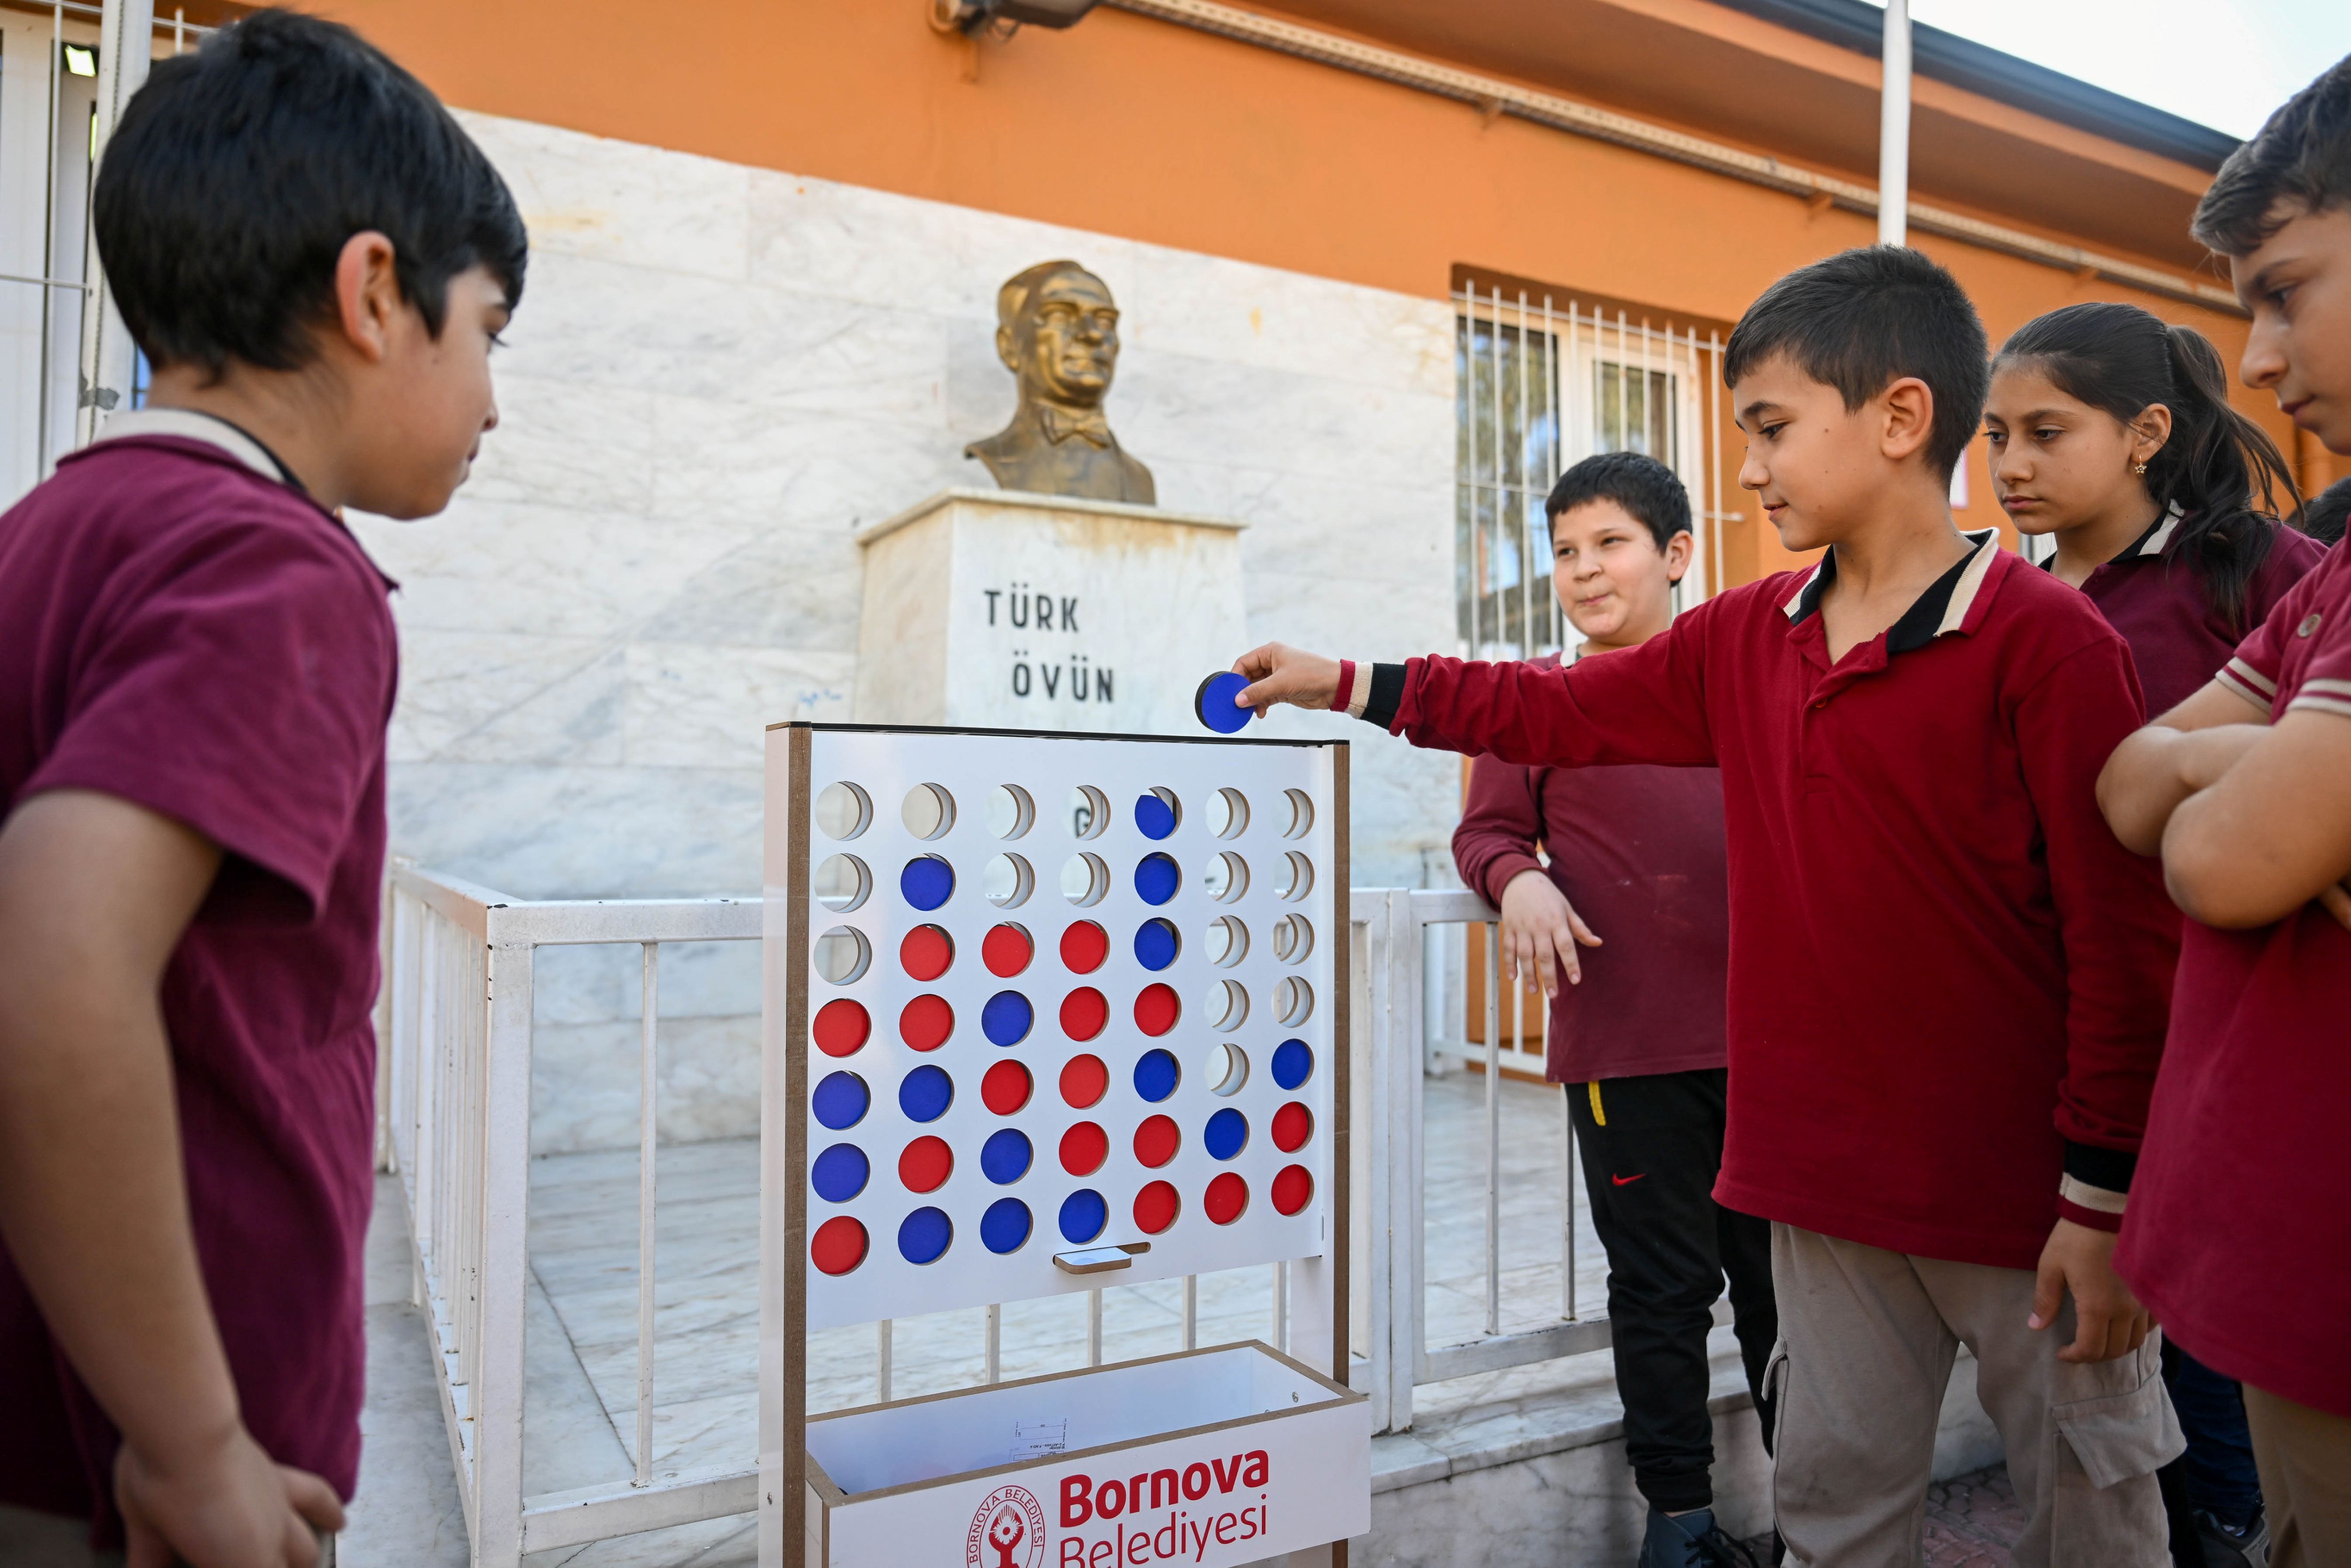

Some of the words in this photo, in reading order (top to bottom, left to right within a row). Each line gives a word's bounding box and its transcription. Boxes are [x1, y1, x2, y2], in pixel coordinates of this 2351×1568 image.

[984, 582, 1079, 633] TÜRK
[1012, 650, 1114, 703] ÖVÜN
[1060, 1449, 1269, 1528] Bornova
[969, 1495, 1001, 1563] BORNOVA
[1005, 1489, 1044, 1547] BELEDİYESİ
[1060, 1493, 1267, 1568] Belediyesi
